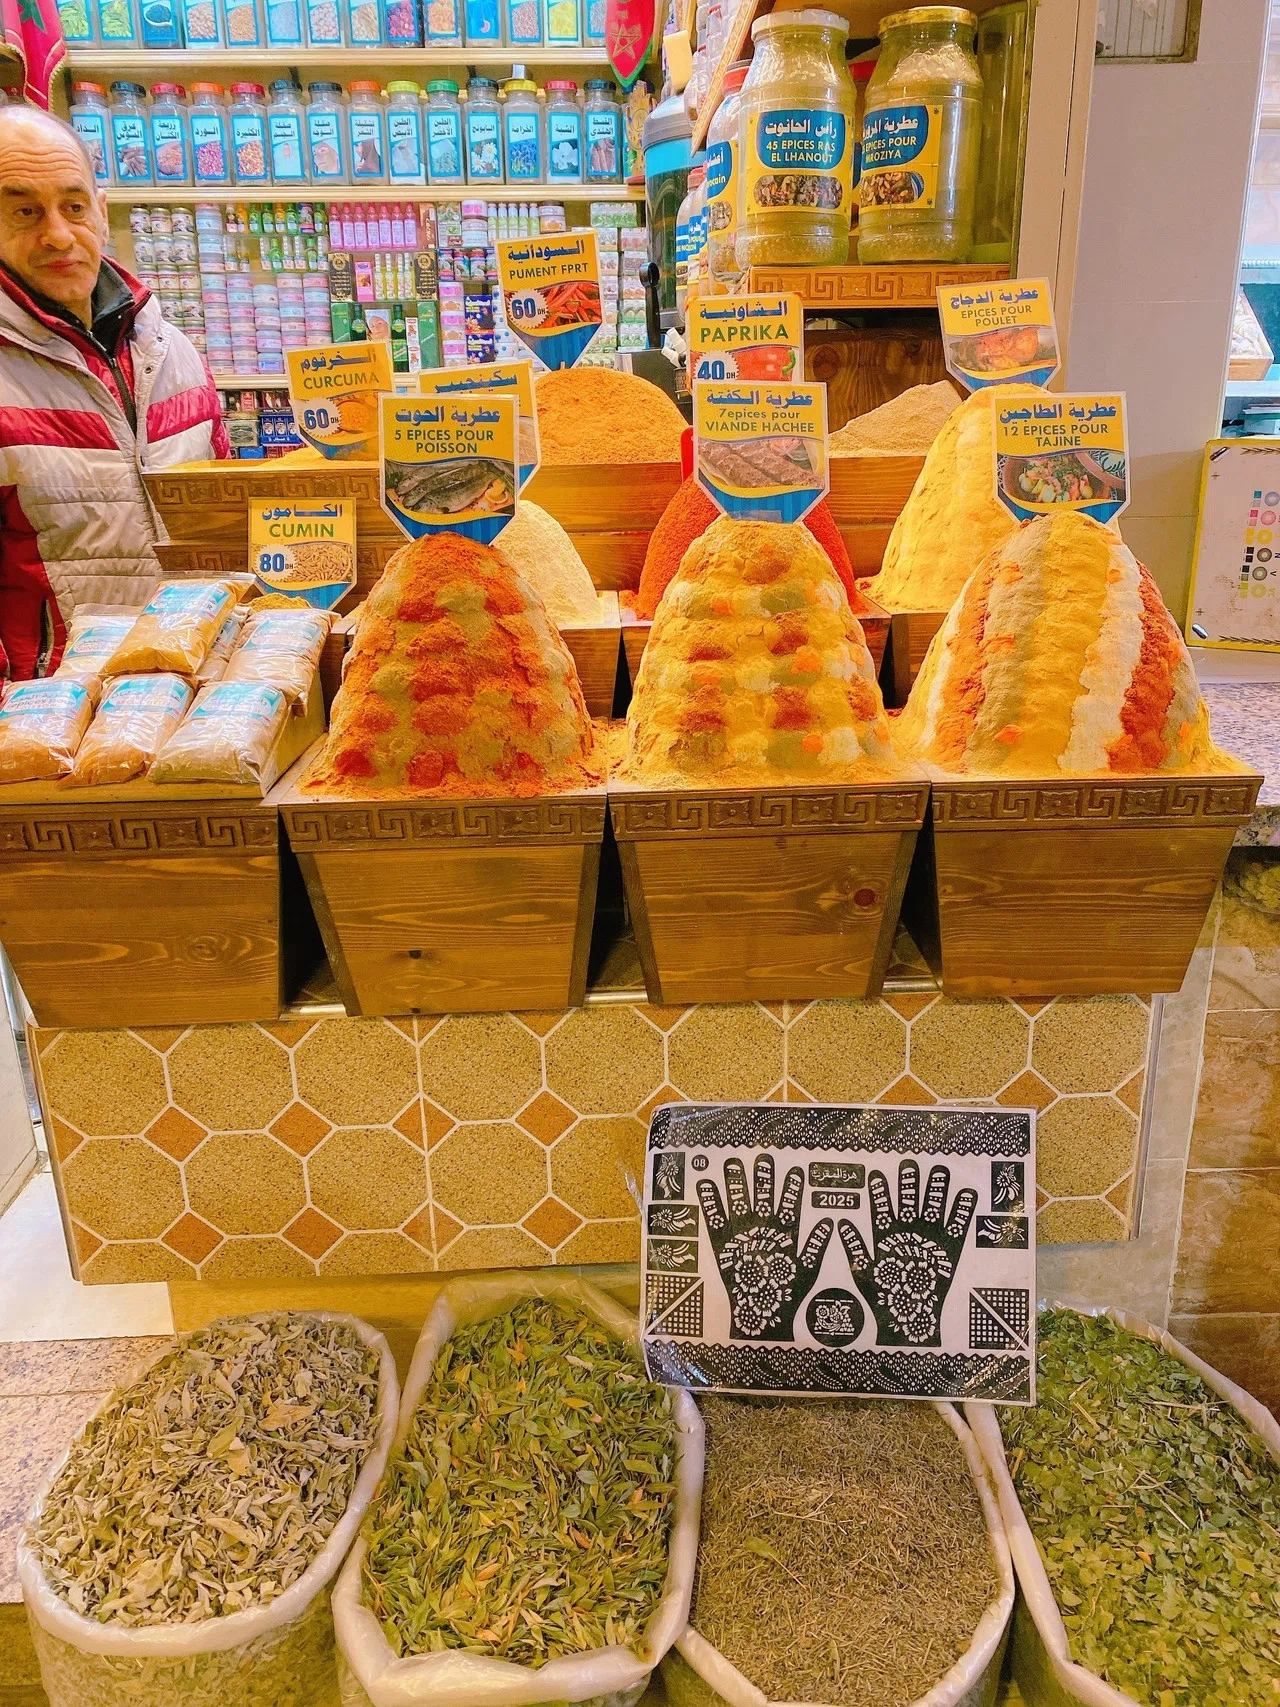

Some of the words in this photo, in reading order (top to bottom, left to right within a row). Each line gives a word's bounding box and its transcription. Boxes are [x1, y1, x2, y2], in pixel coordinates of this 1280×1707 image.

[765, 119, 811, 137] الحانوت
[815, 118, 837, 139] رأس
[884, 115, 919, 134] عطرية
[766, 141, 779, 151] 45
[781, 140, 815, 151] EPICES
[817, 141, 836, 152] RAS
[888, 136, 917, 147] POUR
[771, 153, 782, 163] EL
[784, 153, 833, 164] LHANOUT
[509, 266, 557, 280] PUMENT
[561, 262, 588, 274] FPRT
[950, 291, 994, 309] الدجاج
[999, 288, 1039, 304] عطرية
[511, 297, 536, 319] 60
[961, 308, 997, 319] EPICES
[1001, 305, 1032, 315] POUR
[975, 315, 1017, 327] POULET
[700, 324, 789, 343] PAPRIKA
[697, 360, 725, 380] 40
[303, 372, 380, 390] CURCUMA
[706, 389, 760, 405] الكفتة
[766, 390, 813, 409] عطرية
[303, 408, 330, 430] 60
[395, 405, 445, 426] الحوت
[451, 405, 501, 427] عطرية
[771, 411, 801, 421] pour
[1000, 403, 1063, 424] الطاجين
[394, 429, 402, 440] 5
[407, 429, 451, 441] EPICES
[456, 430, 494, 441] POUR
[706, 421, 757, 432] VIANDE
[762, 422, 815, 433] HACHEE
[1003, 426, 1018, 436] 12
[1023, 424, 1066, 436] EPICES
[1071, 423, 1109, 434] POUR
[416, 442, 478, 453] POISSON
[1035, 436, 1081, 447] TAJINE
[262, 503, 343, 521] الكامون
[269, 523, 334, 538] CUMIN
[259, 553, 285, 573] 80
[693, 1157, 706, 1169] 08
[819, 1195, 855, 1207] 2025
